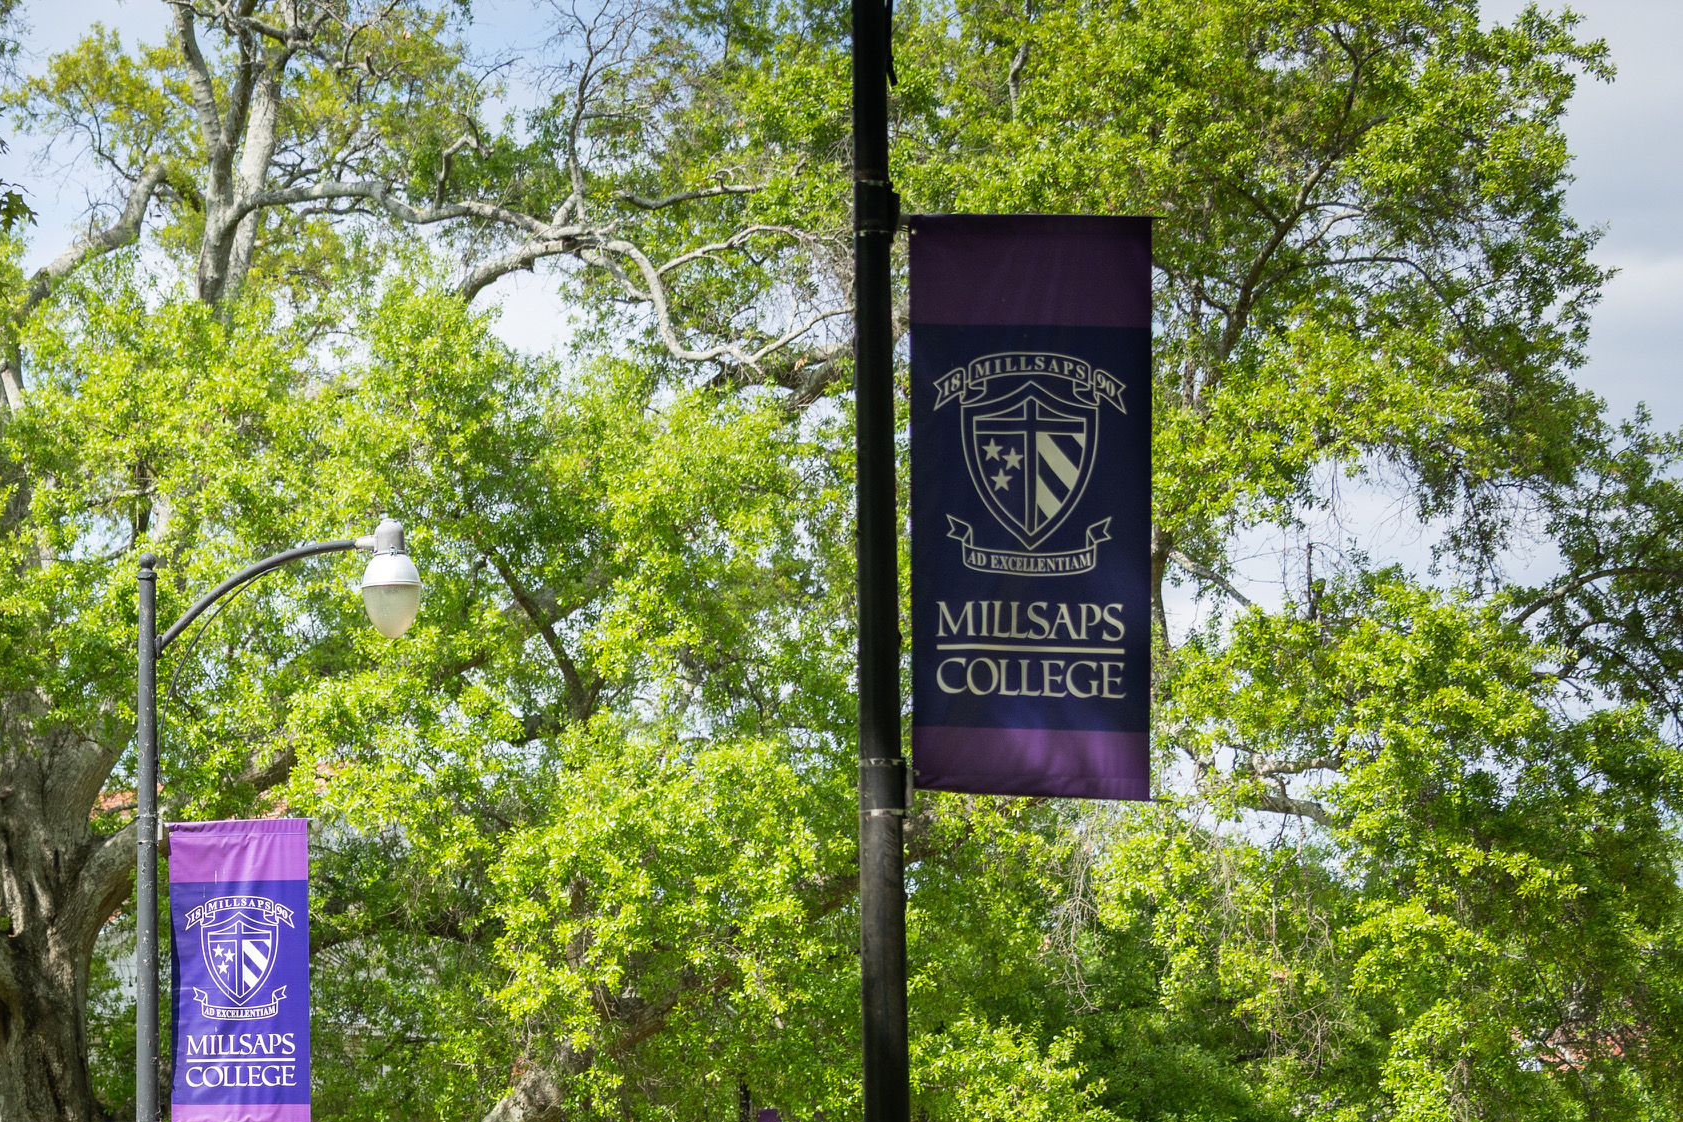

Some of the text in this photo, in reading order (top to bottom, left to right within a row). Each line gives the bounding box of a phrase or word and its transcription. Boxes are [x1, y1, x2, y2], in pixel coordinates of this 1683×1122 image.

[942, 356, 1116, 397] 18 MILLSAPS 90
[967, 551, 1092, 573] AD EXCELLENTIAM
[936, 601, 1125, 641] MILLSAPS
[936, 657, 1126, 699] COLLEGE
[190, 898, 289, 923] 18 MILLSAPS 90
[204, 1005, 276, 1019] AD EXCELLENTIAM
[186, 1033, 295, 1056] MILLSAPS
[185, 1065, 297, 1088] COLLEGE
